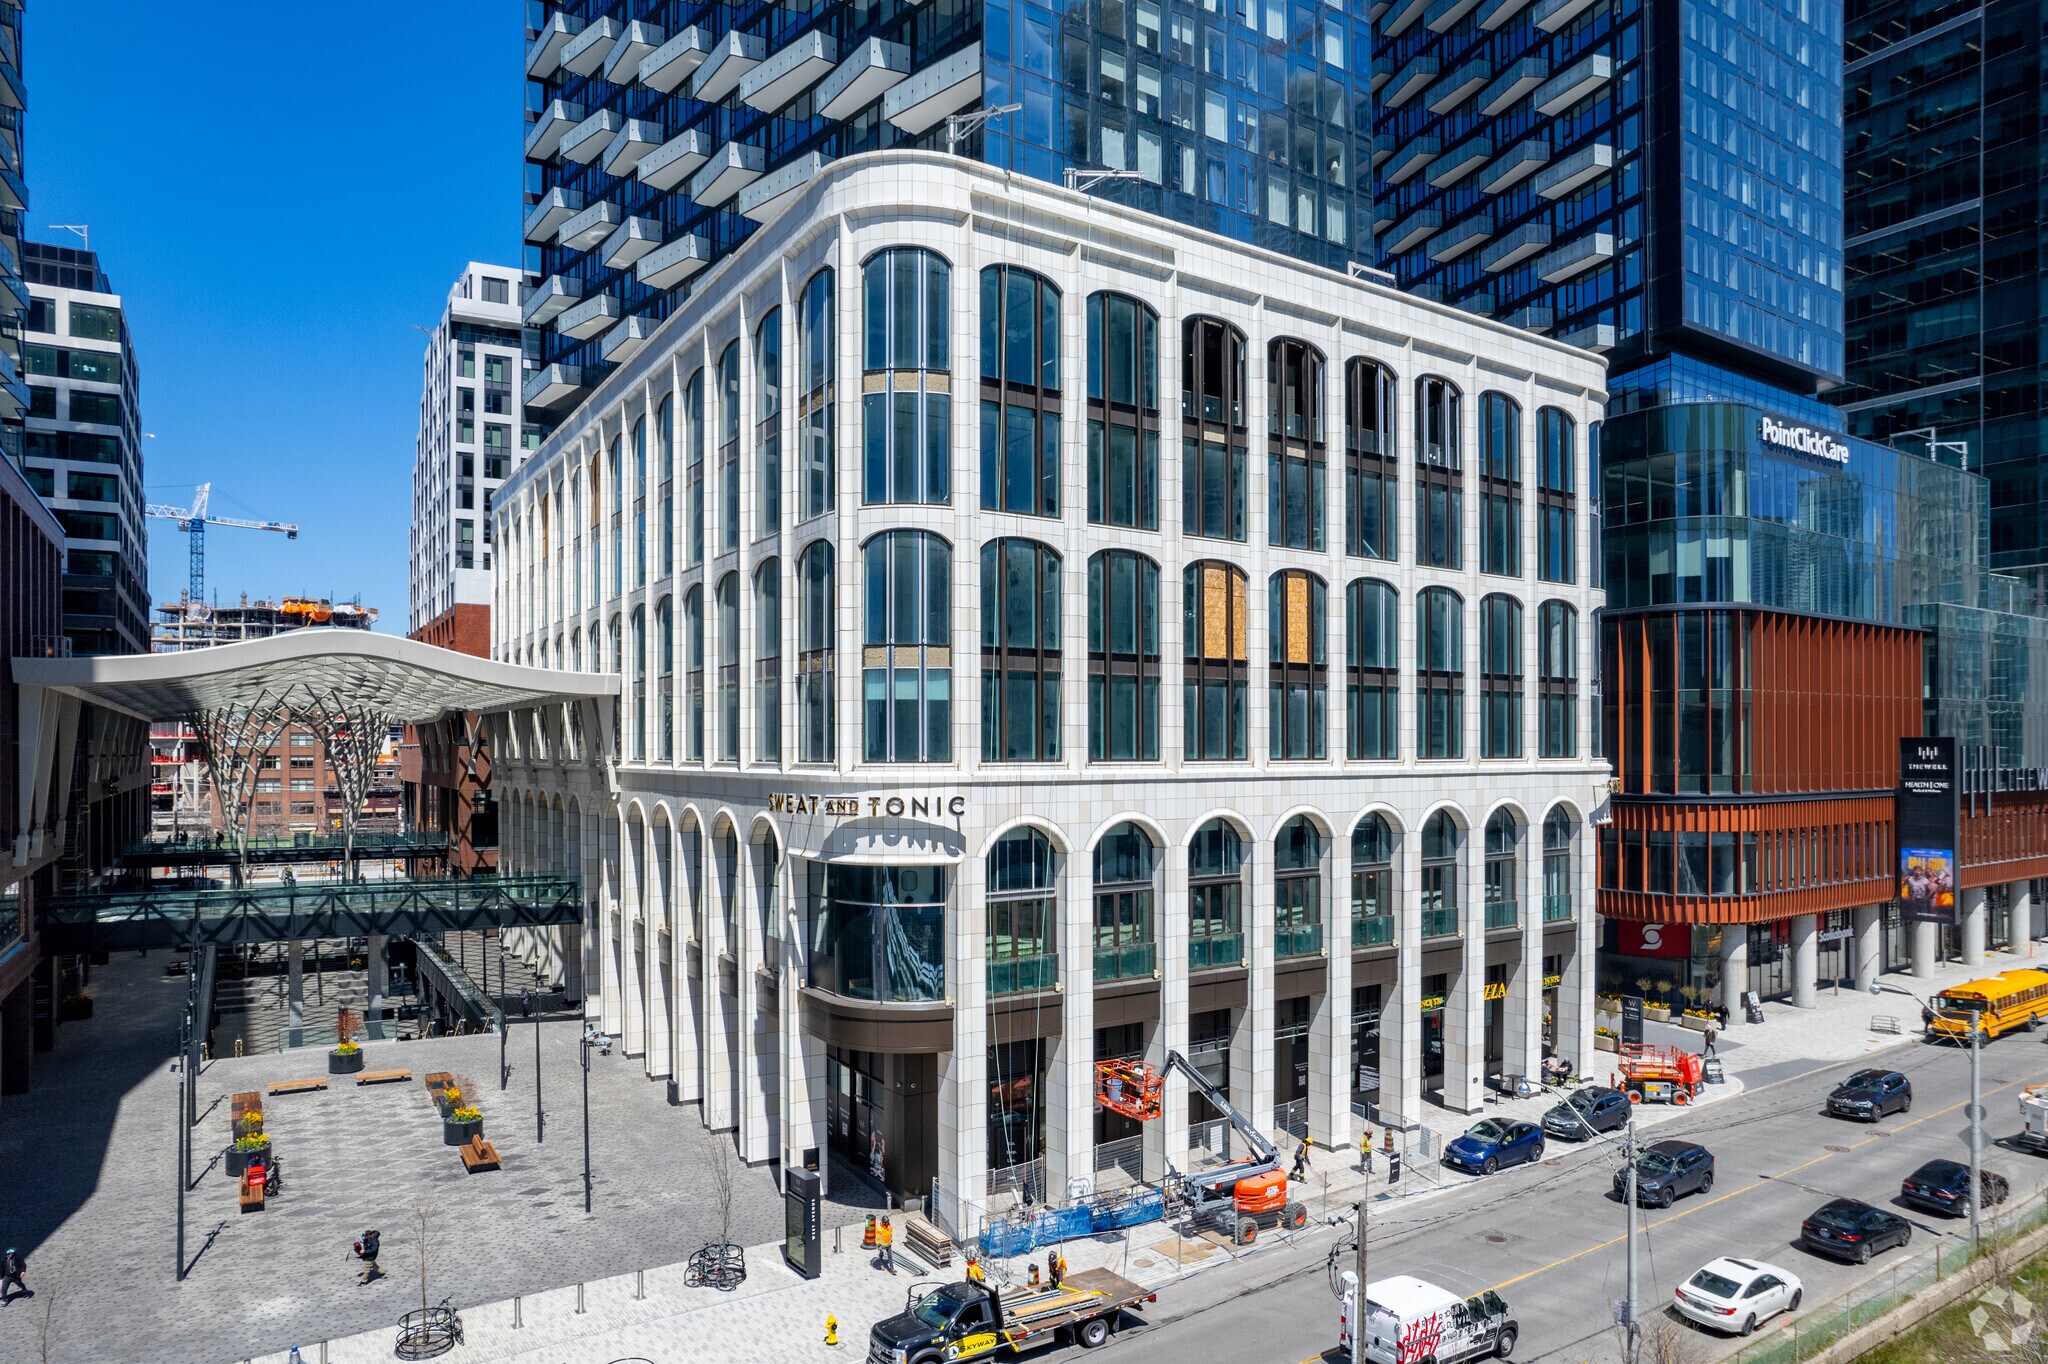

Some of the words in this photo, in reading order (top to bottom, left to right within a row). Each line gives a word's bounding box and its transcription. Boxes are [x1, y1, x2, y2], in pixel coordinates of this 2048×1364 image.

[1762, 417, 1849, 463] PointClickCare
[768, 793, 820, 816] SWEAT
[825, 799, 859, 812] AND
[869, 796, 966, 817] TONIC
[1484, 982, 1507, 1001] ZZA
[959, 1338, 995, 1354] SKYWAY
